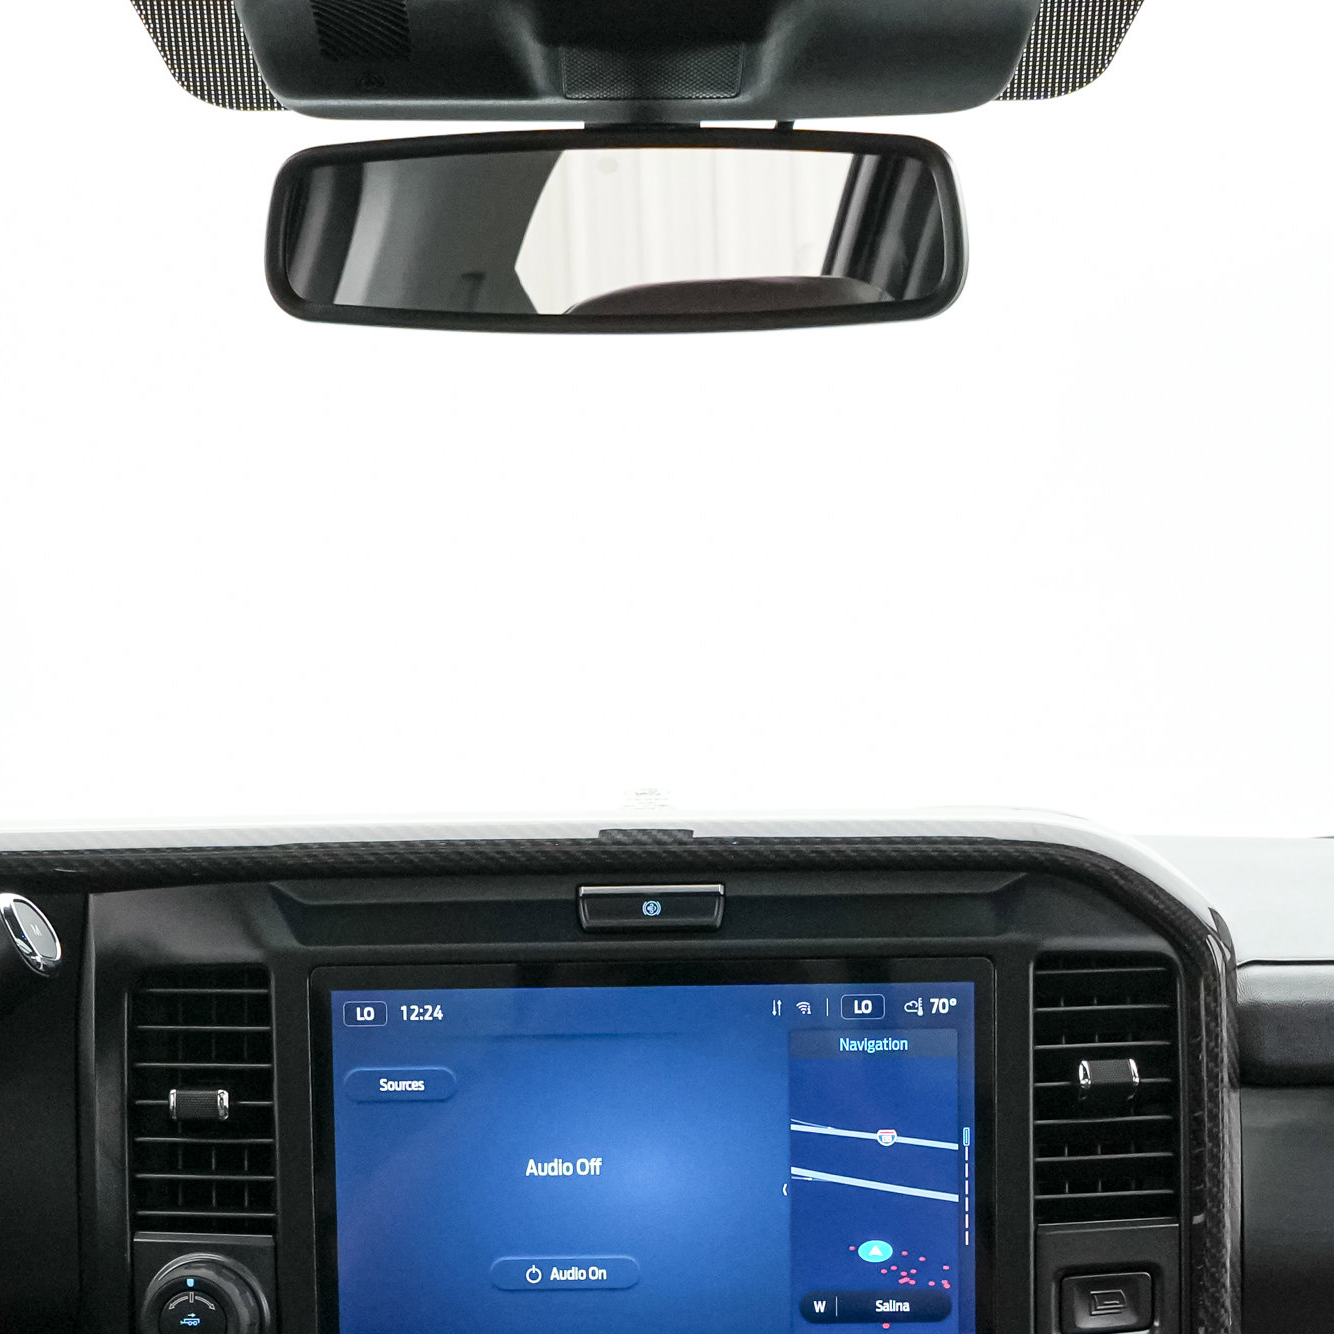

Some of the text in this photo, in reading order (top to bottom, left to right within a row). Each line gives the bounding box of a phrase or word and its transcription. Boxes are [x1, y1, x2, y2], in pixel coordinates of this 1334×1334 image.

[356, 1005, 444, 1021] LO 12:24
[854, 998, 957, 1014] LO 70°
[839, 1037, 908, 1053] Navigation
[379, 1078, 425, 1092] Sources
[525, 1157, 602, 1176] Audio Off
[550, 1267, 607, 1281] Audio On
[813, 1301, 826, 1313] W
[875, 1300, 910, 1312] Salina
